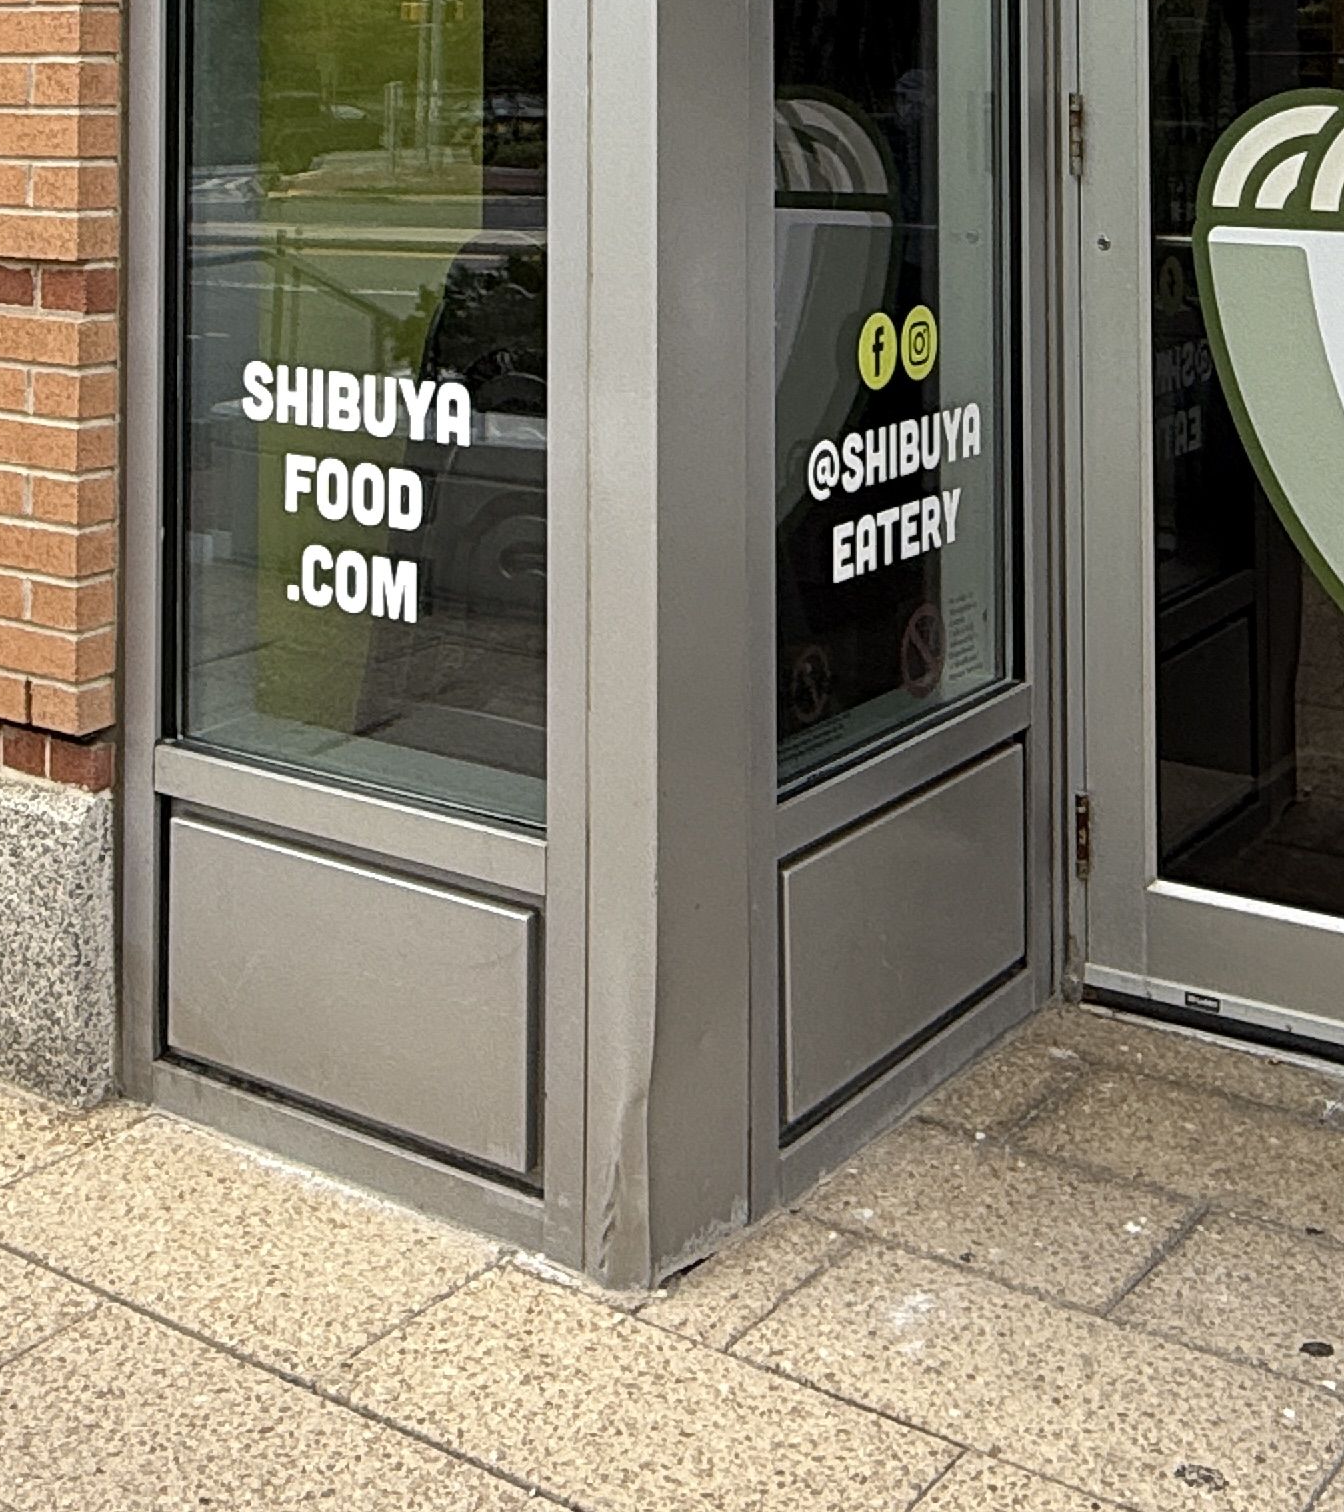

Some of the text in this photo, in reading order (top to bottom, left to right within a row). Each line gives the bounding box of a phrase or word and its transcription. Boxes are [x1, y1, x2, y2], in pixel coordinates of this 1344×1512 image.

[241, 359, 472, 448] SHIBUYA
[283, 452, 424, 532] FOOD
[807, 402, 982, 502] @SHIBUYA
[832, 487, 962, 585] EATERY
[286, 543, 419, 625] .COM
